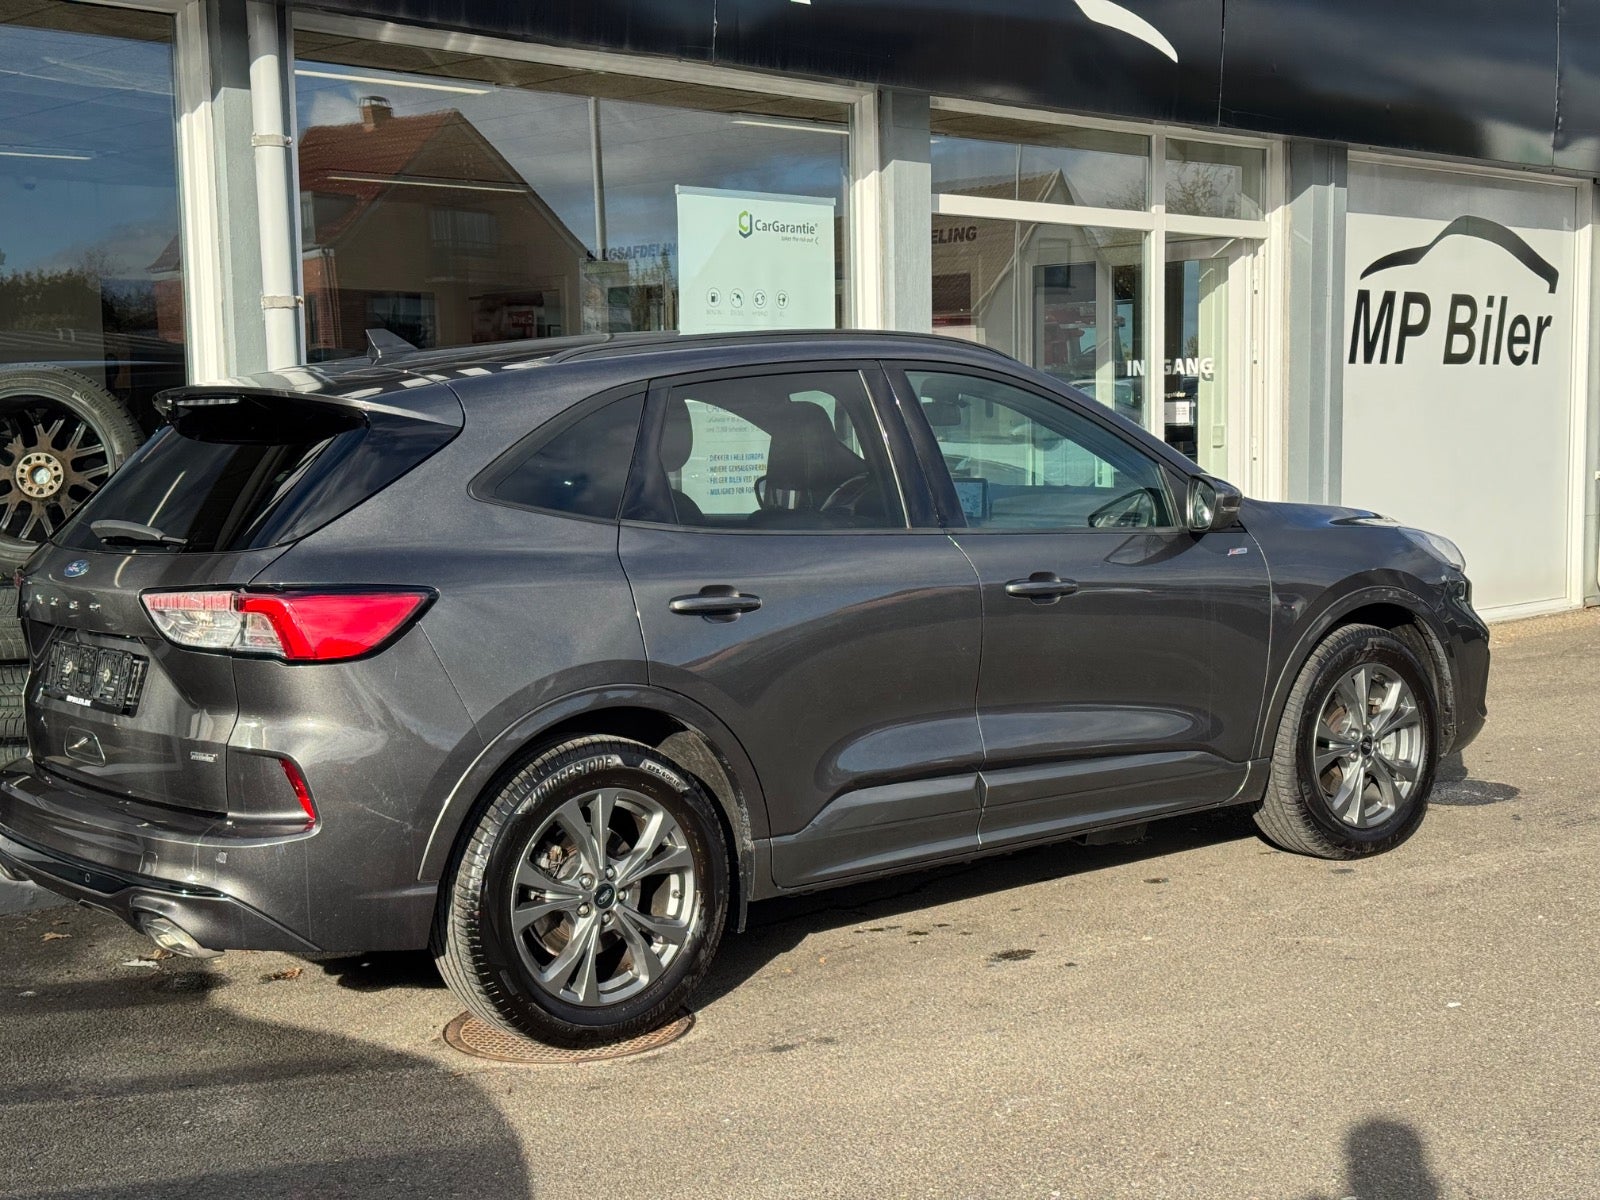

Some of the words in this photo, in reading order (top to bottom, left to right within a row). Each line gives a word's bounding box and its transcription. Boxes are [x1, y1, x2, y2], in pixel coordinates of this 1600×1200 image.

[755, 219, 816, 235] CarGarantie
[1348, 289, 1431, 365] MP
[1443, 293, 1553, 366] Biler
